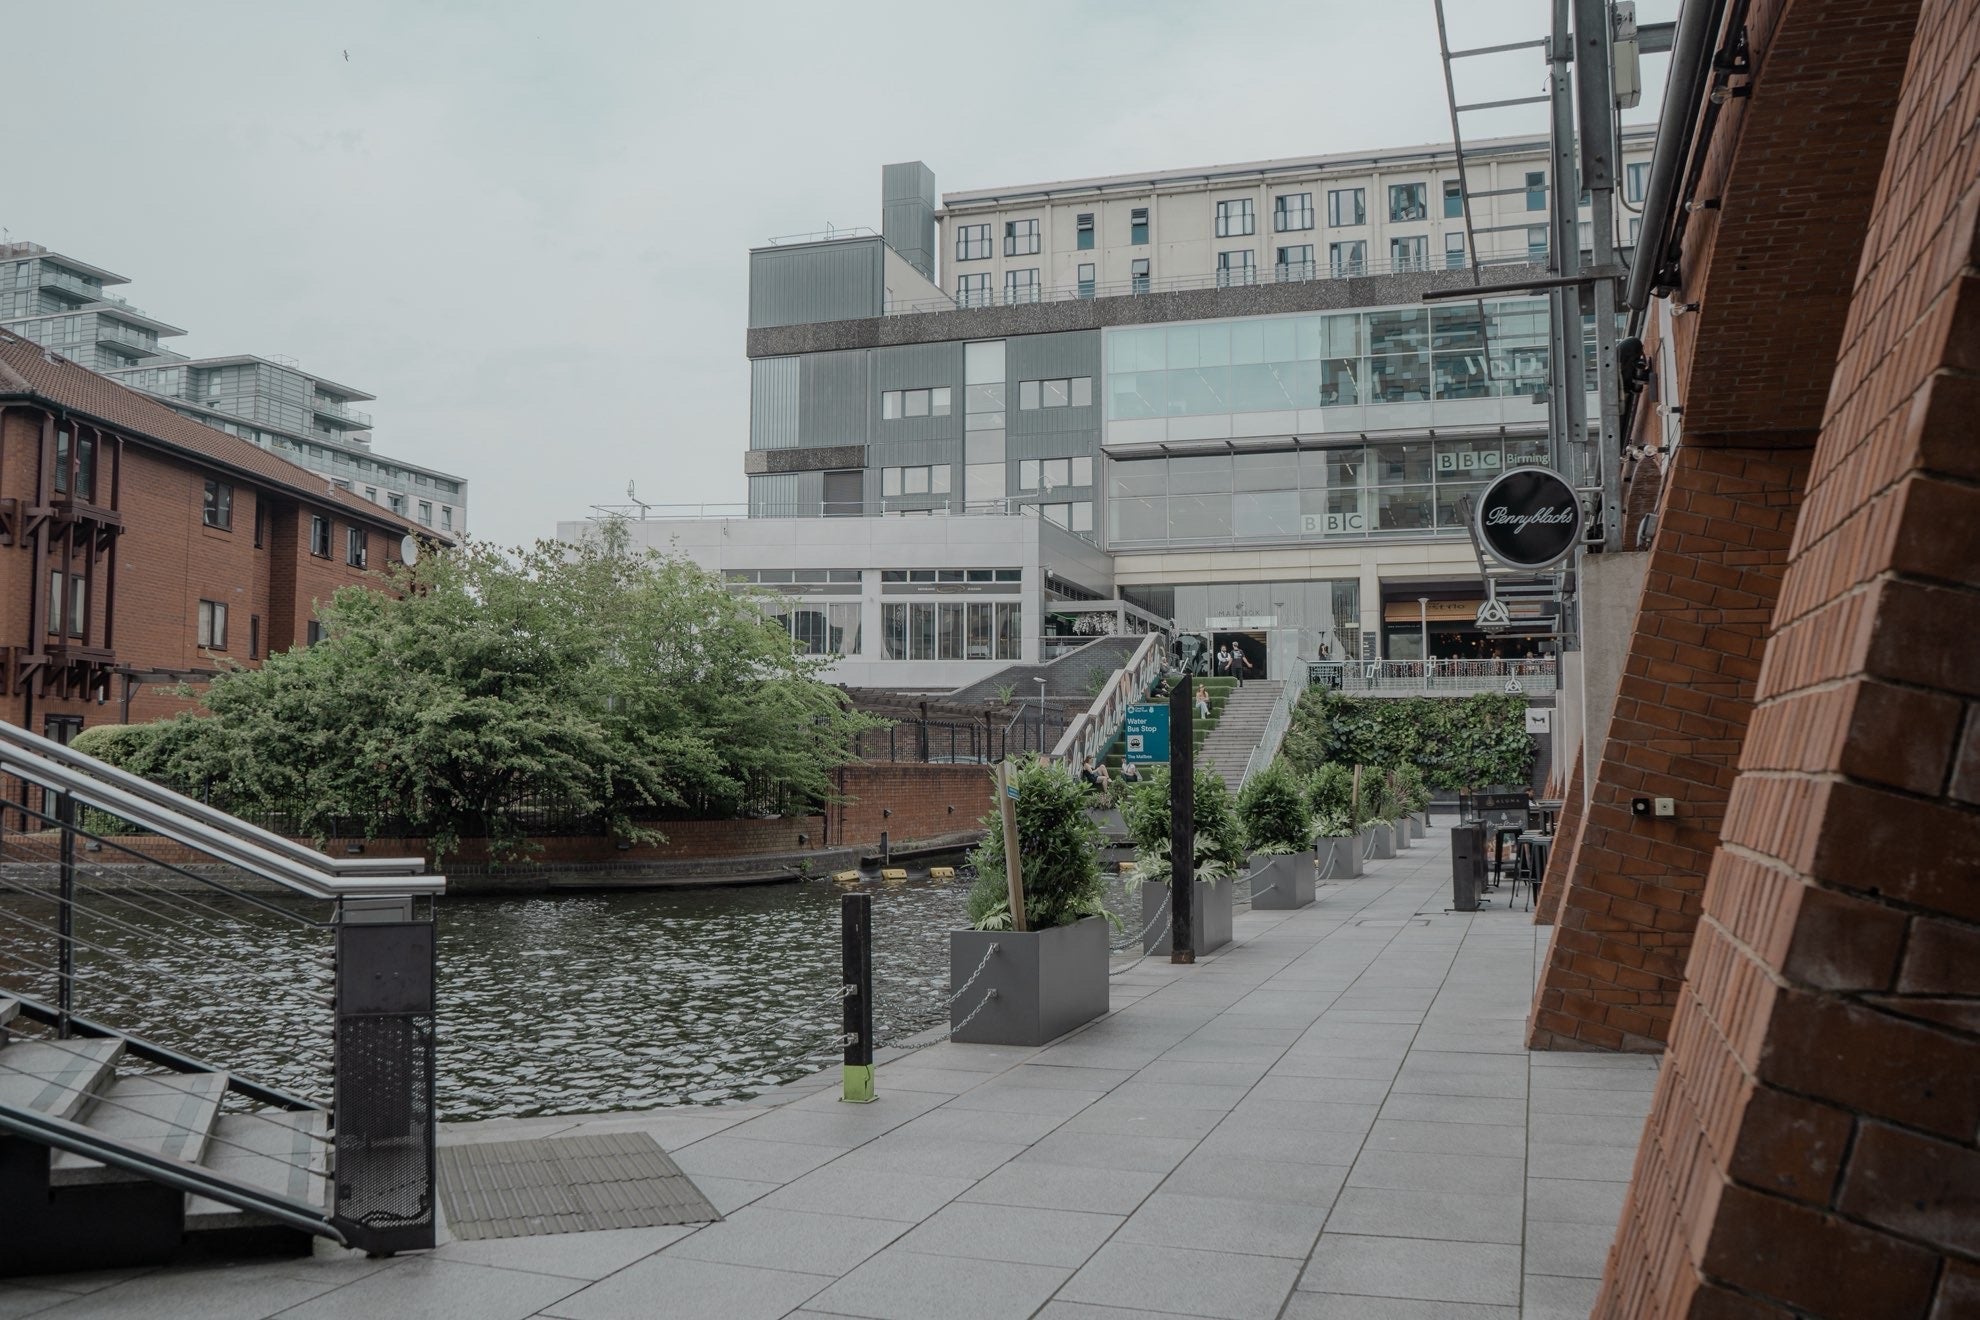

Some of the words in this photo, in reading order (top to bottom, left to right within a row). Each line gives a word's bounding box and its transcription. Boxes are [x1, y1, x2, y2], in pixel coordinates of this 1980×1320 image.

[1439, 451, 1499, 470] BBC
[1506, 453, 1550, 464] Birming
[1303, 514, 1364, 532] BBC
[1486, 506, 1573, 534] Pennyblacks
[1141, 725, 1157, 733] Stop
